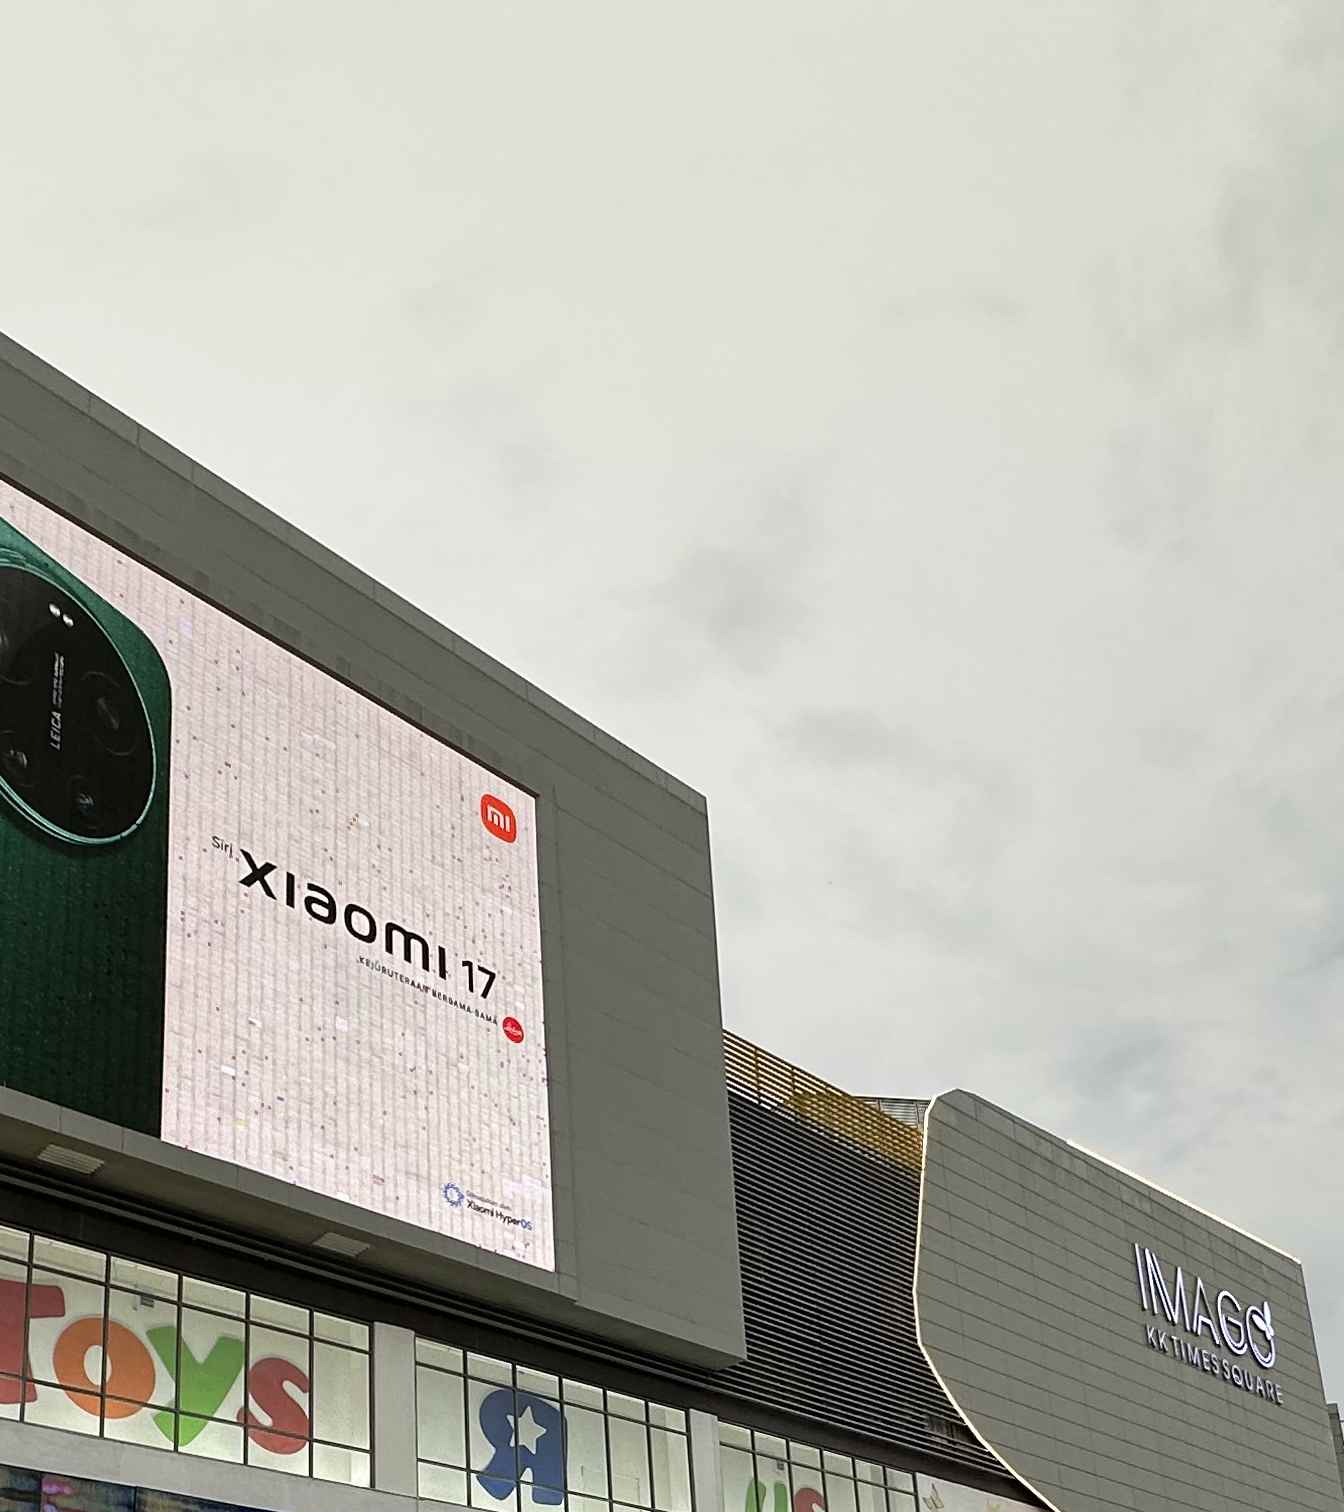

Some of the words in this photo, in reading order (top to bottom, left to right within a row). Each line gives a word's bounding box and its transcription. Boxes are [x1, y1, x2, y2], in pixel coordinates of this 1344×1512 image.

[462, 960, 497, 999] 17
[1134, 1243, 1277, 1369] IMAGO
[1146, 1325, 1168, 1352] KK
[1170, 1335, 1220, 1376] TIMES
[1221, 1358, 1284, 1405] SQUARE
